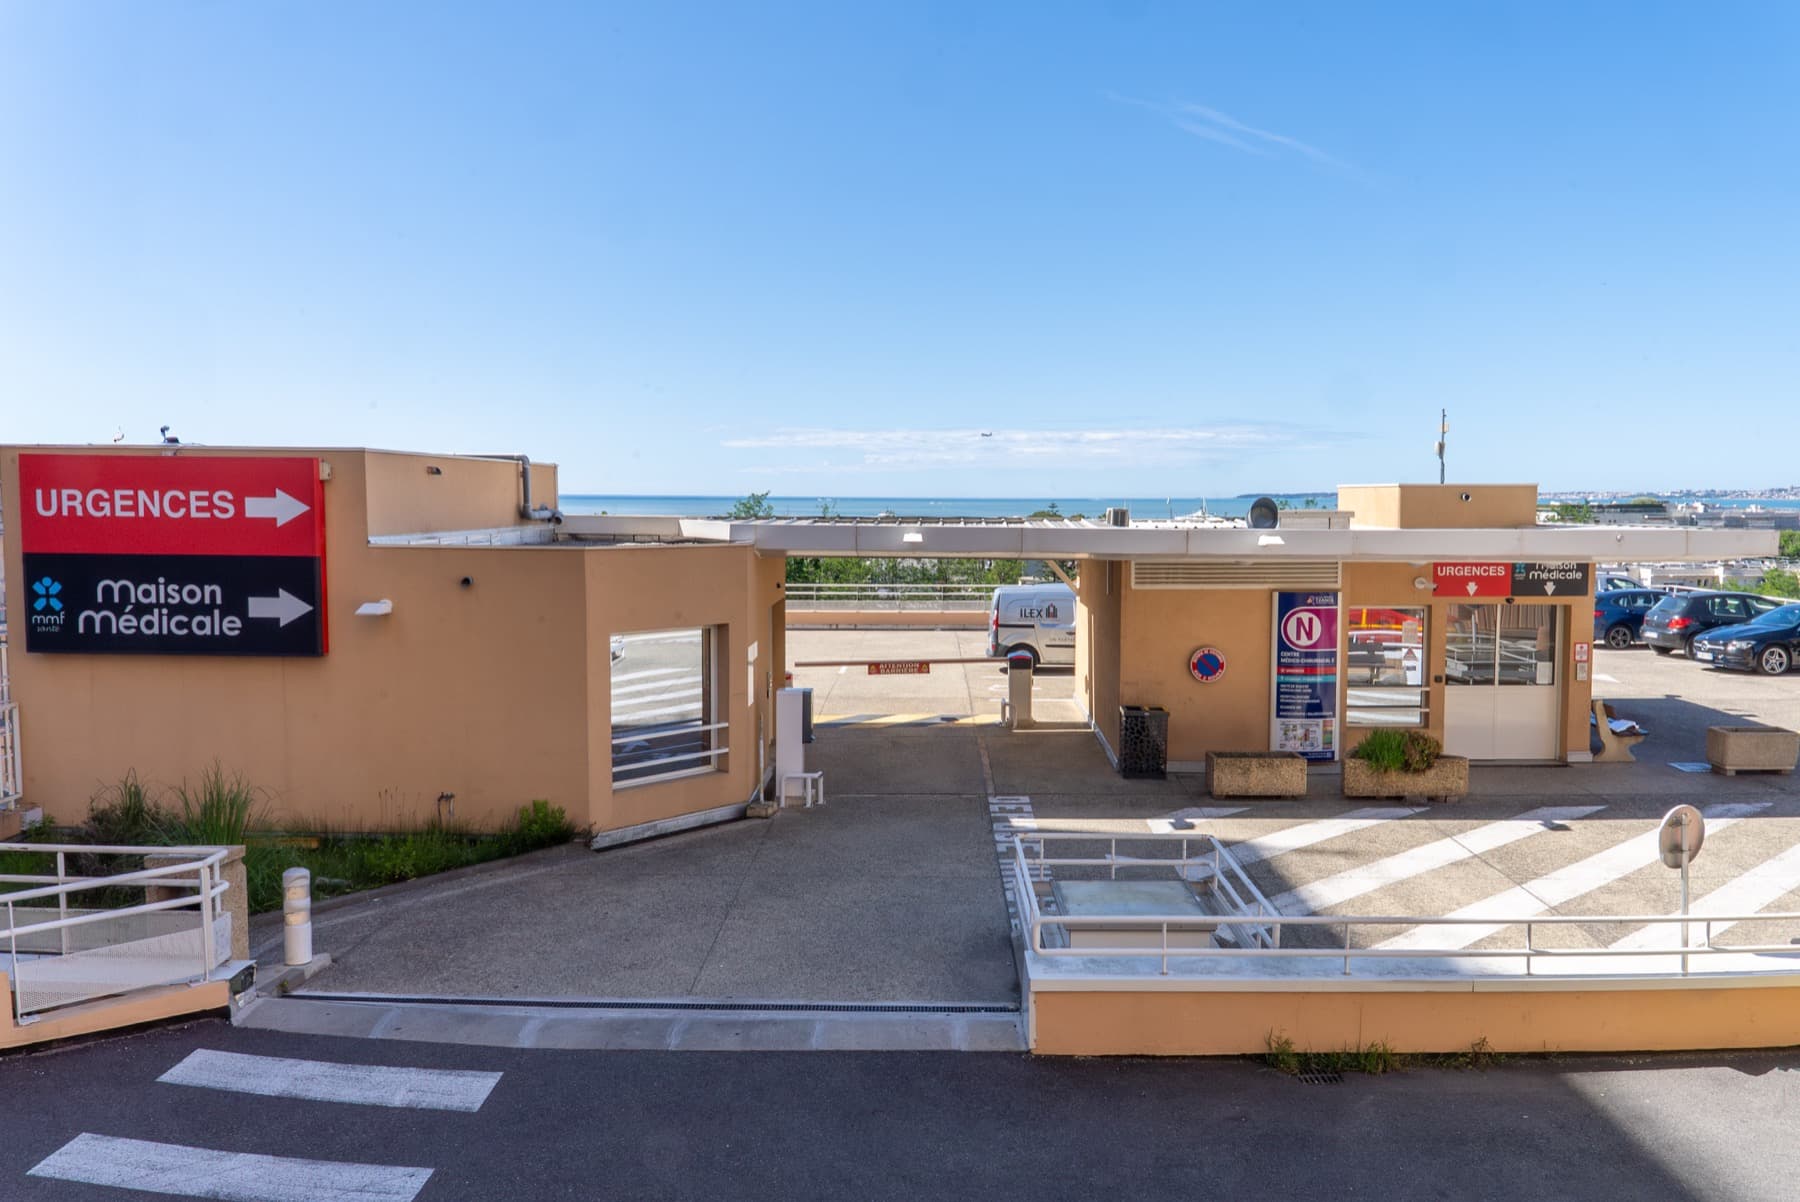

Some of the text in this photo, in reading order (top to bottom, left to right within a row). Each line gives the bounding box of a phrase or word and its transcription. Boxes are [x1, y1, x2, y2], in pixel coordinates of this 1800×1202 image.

[35, 488, 235, 519] URGENCES
[1437, 566, 1505, 577] URGENCES
[1529, 568, 1583, 580] médicale
[97, 577, 222, 604] maison
[32, 611, 65, 625] mmf
[78, 605, 243, 636] médicale
[1020, 608, 1043, 618] ILEX
[1296, 616, 1313, 641] N
